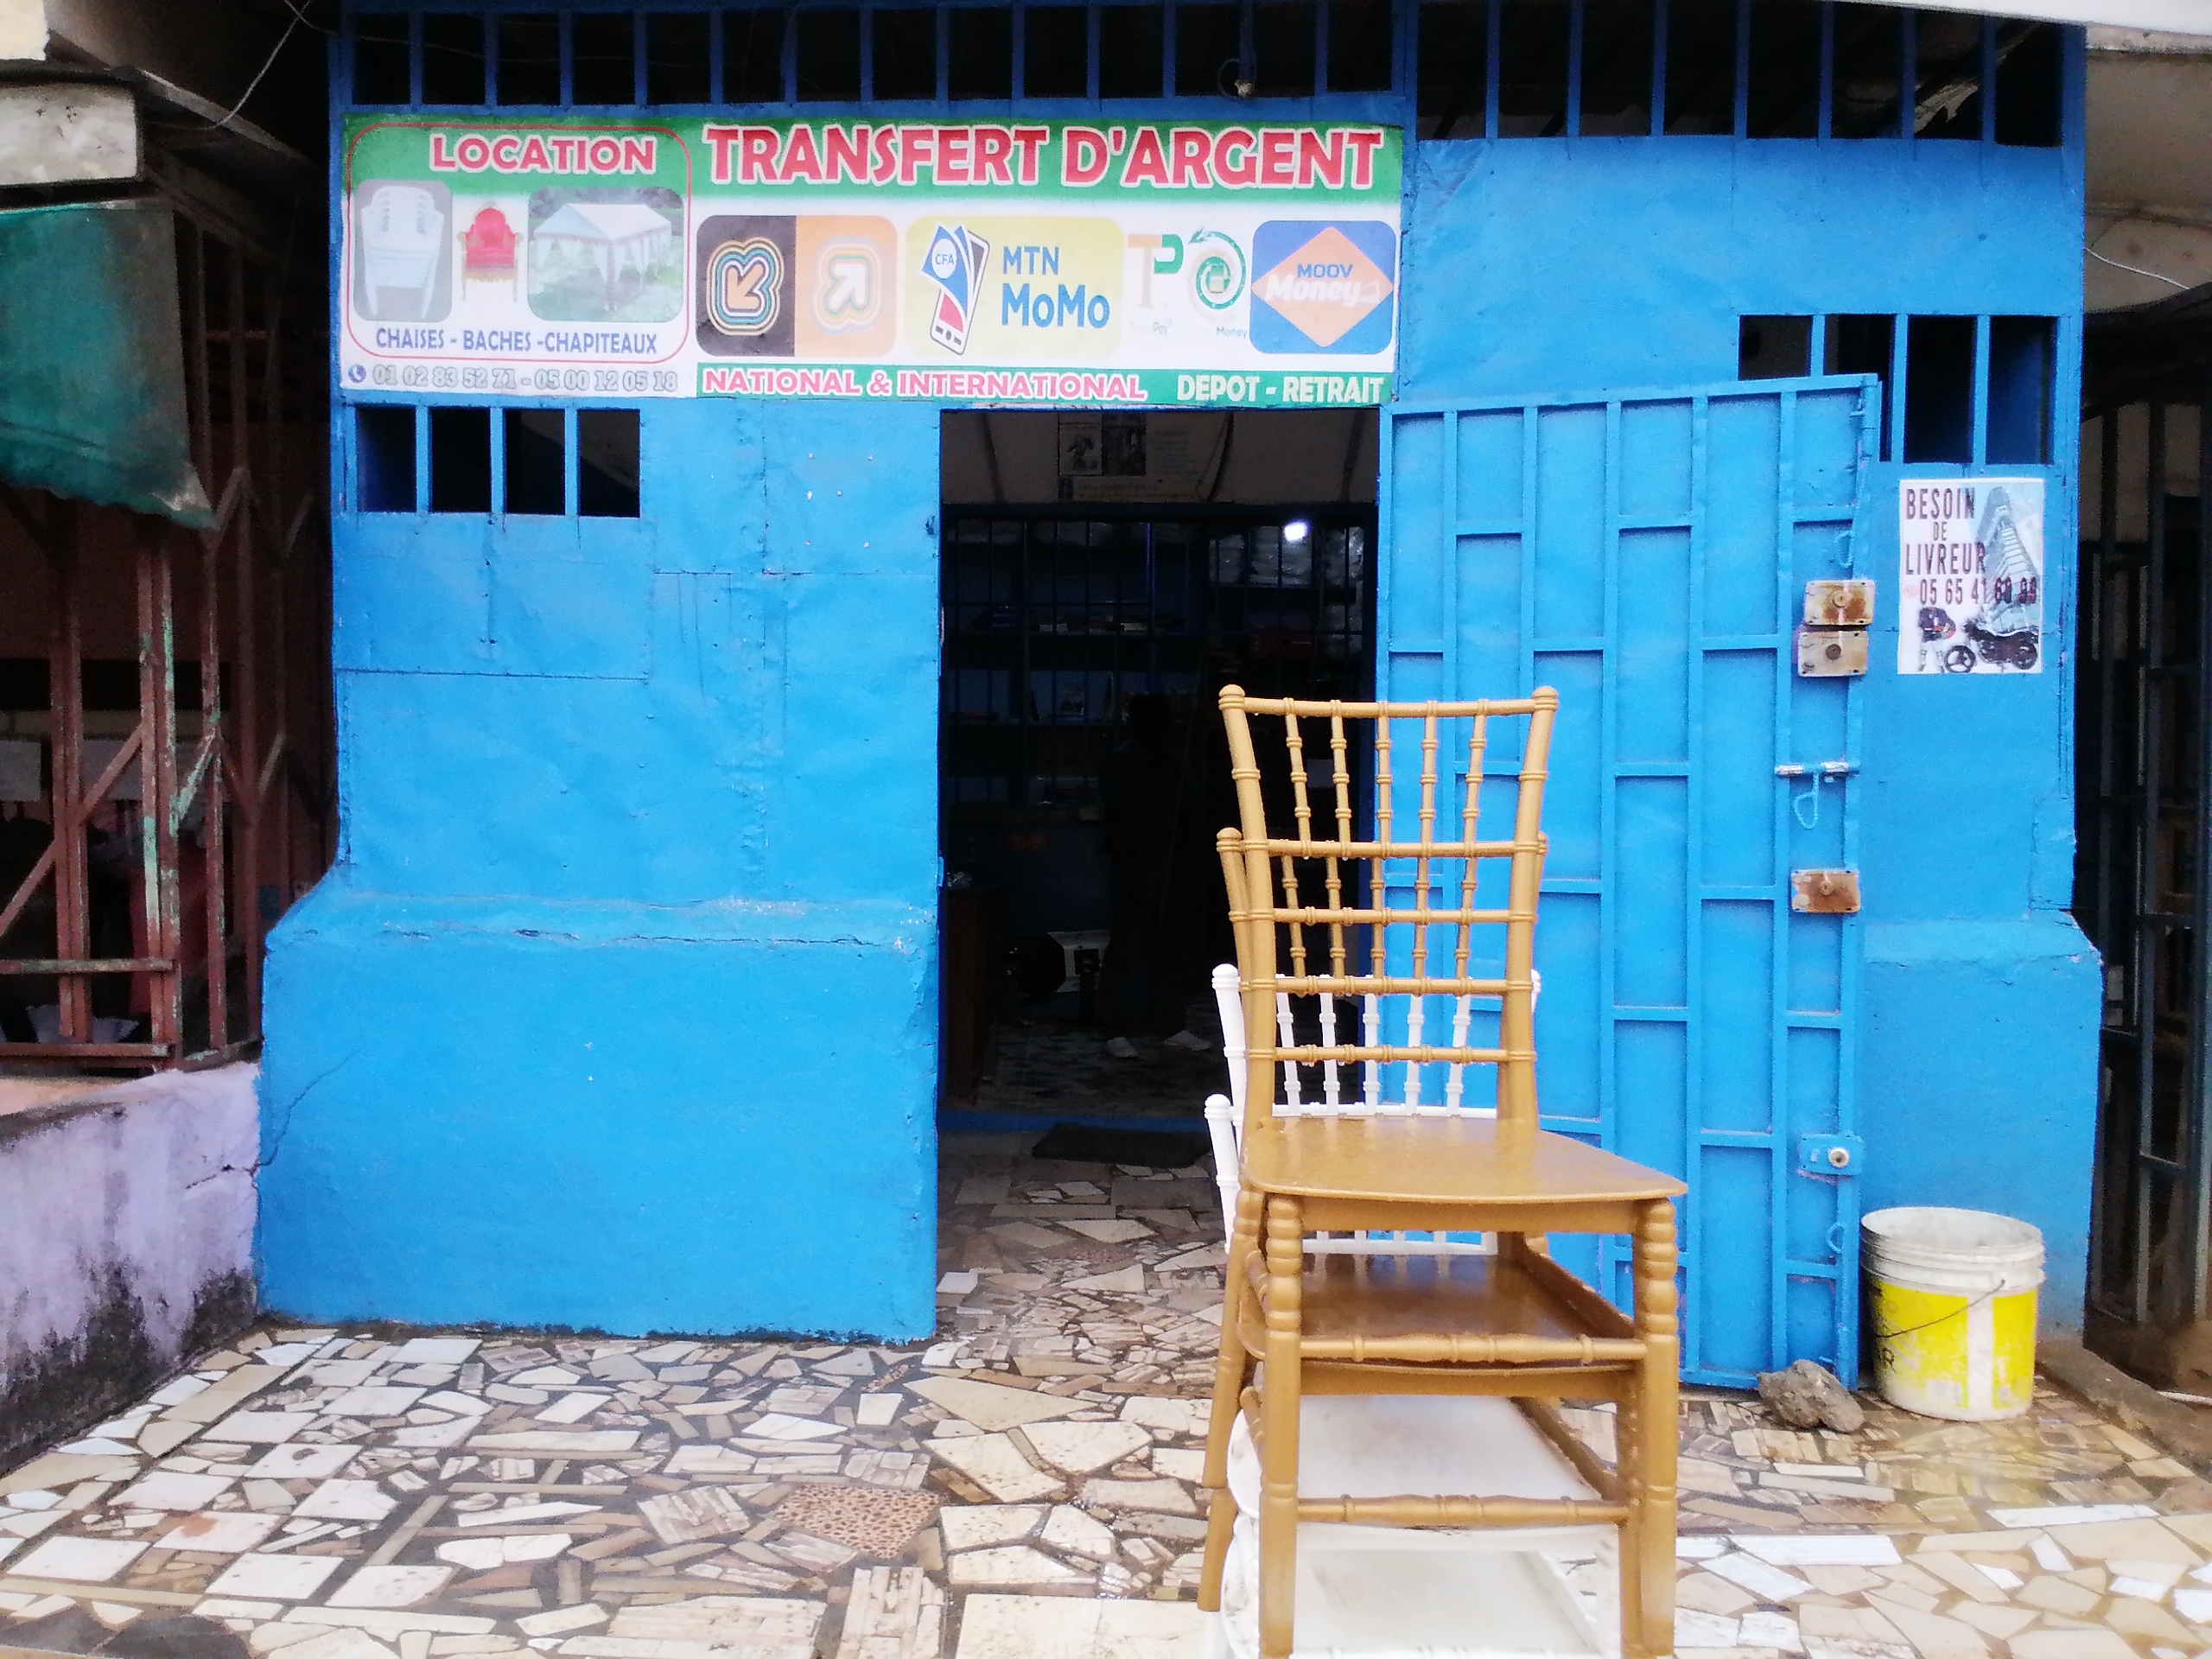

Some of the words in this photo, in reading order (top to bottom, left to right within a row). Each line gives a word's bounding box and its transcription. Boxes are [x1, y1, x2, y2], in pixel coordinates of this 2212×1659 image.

[431, 136, 655, 172] LOCATION
[702, 126, 1048, 184] TRANSFERT
[1063, 128, 1383, 188] D'ARGENT
[934, 253, 956, 266] CFA
[1002, 245, 1060, 276] MTN
[1297, 264, 1354, 278] MOOV
[1001, 283, 1110, 328] MoMo
[1264, 274, 1363, 308] Money
[375, 327, 445, 349] CHAISES
[462, 330, 531, 352] BACHES
[372, 364, 398, 385] 01
[403, 365, 429, 387] 02
[432, 366, 459, 388] 83
[462, 366, 488, 389] 52
[492, 368, 518, 389] 71
[534, 369, 560, 391] 05
[563, 370, 590, 391] 00
[594, 370, 620, 391] 12
[623, 371, 648, 391] 05
[653, 371, 679, 392] 18
[704, 369, 861, 396] NATIONAL
[868, 370, 892, 397] &
[899, 371, 1147, 400] INTERNATIONAL
[1178, 374, 1260, 402] DEPOT
[1282, 375, 1385, 404] RETRAIT
[1905, 487, 1975, 520] BESOIN
[1933, 521, 1948, 542] DE
[1904, 542, 1986, 575] LIVREUR
[1919, 578, 1937, 606] 05
[1945, 578, 1963, 606] 65
[1970, 578, 1988, 605] 41
